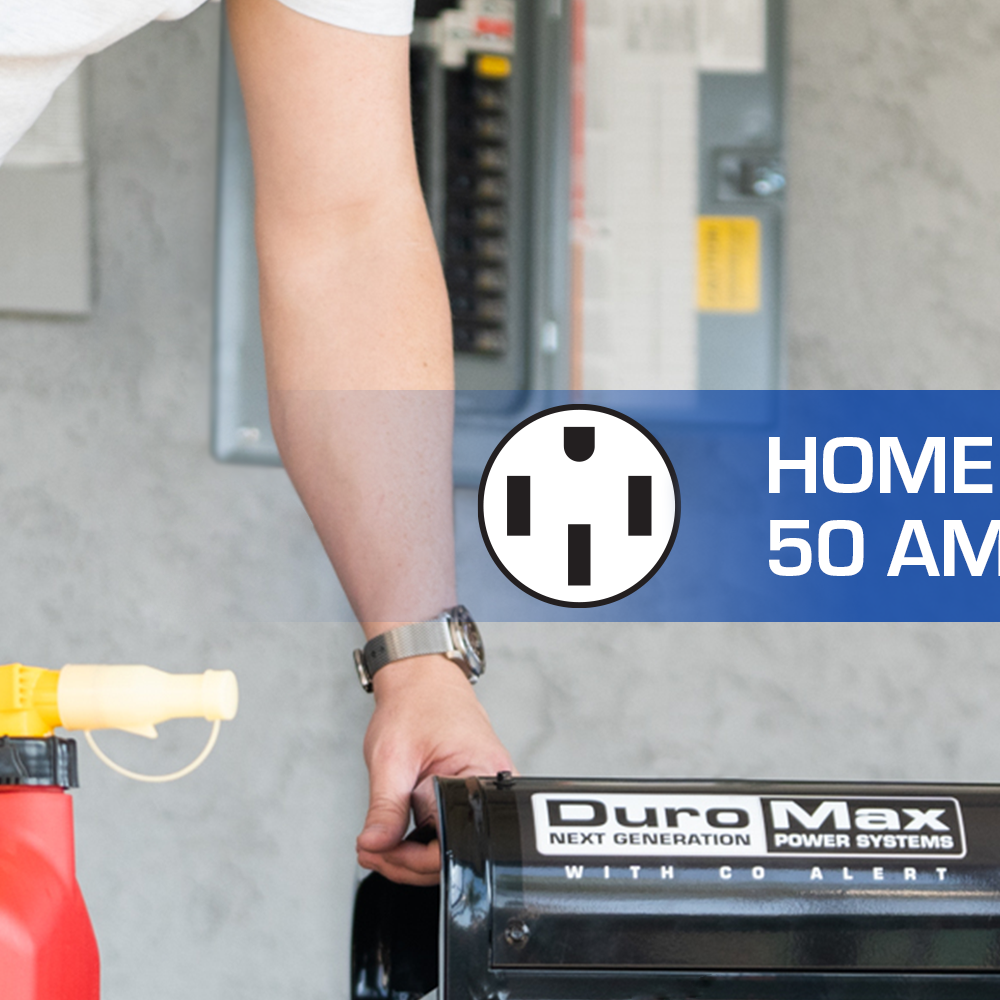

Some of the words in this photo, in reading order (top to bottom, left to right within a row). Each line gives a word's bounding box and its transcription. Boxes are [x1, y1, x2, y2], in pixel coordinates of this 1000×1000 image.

[549, 832, 604, 845] NEXT
[613, 832, 751, 847] GENERATION
[775, 833, 851, 848] POWER
[856, 834, 954, 849] SYSTEMS
[565, 865, 675, 879] WITH
[719, 866, 766, 880] CO
[810, 866, 948, 881] ALERT
